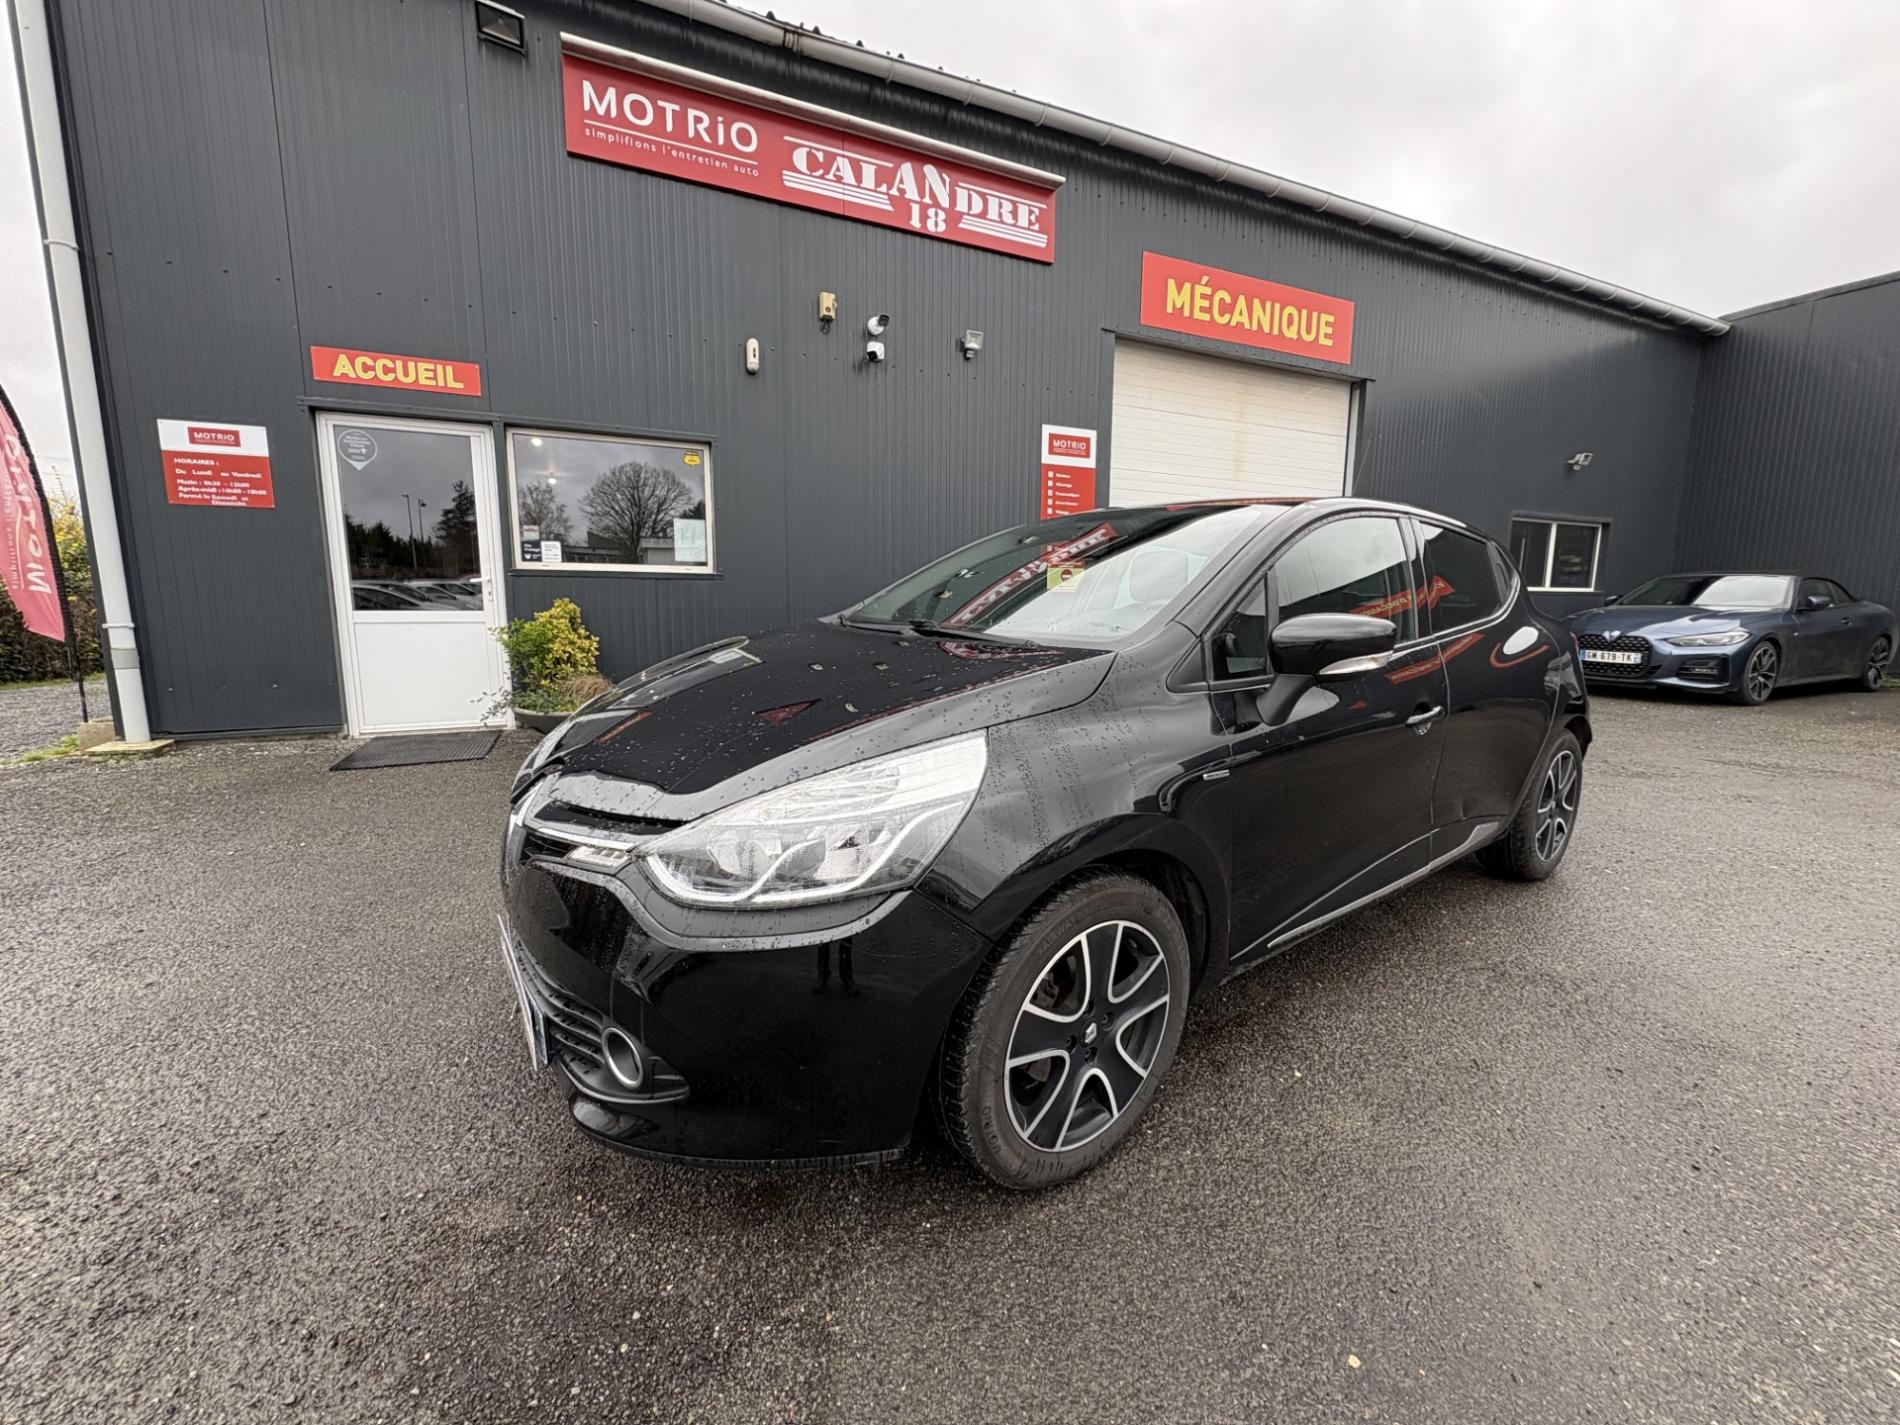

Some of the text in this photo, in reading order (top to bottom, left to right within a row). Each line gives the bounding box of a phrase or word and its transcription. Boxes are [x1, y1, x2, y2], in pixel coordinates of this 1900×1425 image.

[584, 127, 759, 177] simplifions l'entretien auto
[792, 147, 1040, 231] CALANDRE
[909, 202, 946, 232] 18
[1166, 275, 1335, 347] MÉCANIQUE
[333, 353, 464, 389] ACCUEIL
